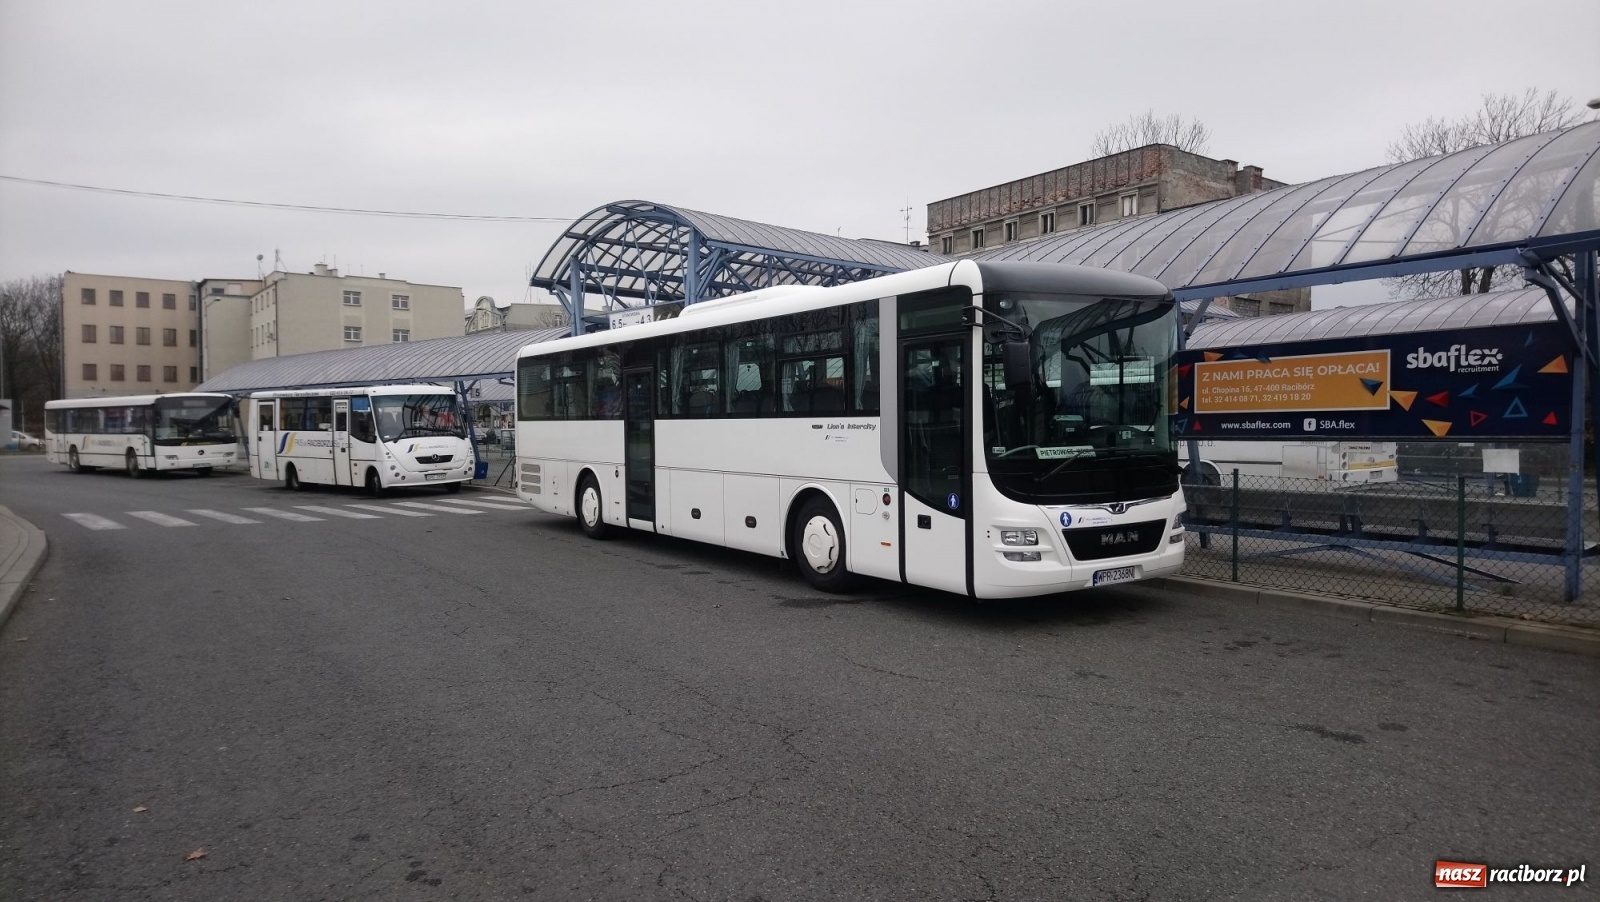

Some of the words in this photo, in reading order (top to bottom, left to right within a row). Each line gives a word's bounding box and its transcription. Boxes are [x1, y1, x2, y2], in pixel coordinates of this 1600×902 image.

[1406, 344, 1502, 372] sbaflex
[1202, 372, 1210, 382] Z
[1213, 370, 1243, 381] NAMI
[1247, 367, 1290, 380] PRACA
[1293, 366, 1314, 379] SIĘ
[1317, 362, 1380, 376] OPŁACA!
[475, 389, 480, 397] 5
[1202, 387, 1210, 395] ul.
[1212, 386, 1240, 395] Chopina
[1241, 385, 1252, 393] 16,
[1254, 384, 1280, 392] 47-400
[1281, 382, 1315, 391] Racibórz
[1202, 396, 1212, 404] tel.
[1250, 395, 1260, 403] 71,
[1262, 394, 1271, 402] 32
[827, 422, 845, 430] Lion's
[847, 422, 876, 431] Intercity
[1221, 420, 1291, 429] www.sbaflex.com
[1320, 420, 1355, 429] SBA.flex
[1101, 531, 1138, 545] MAN
